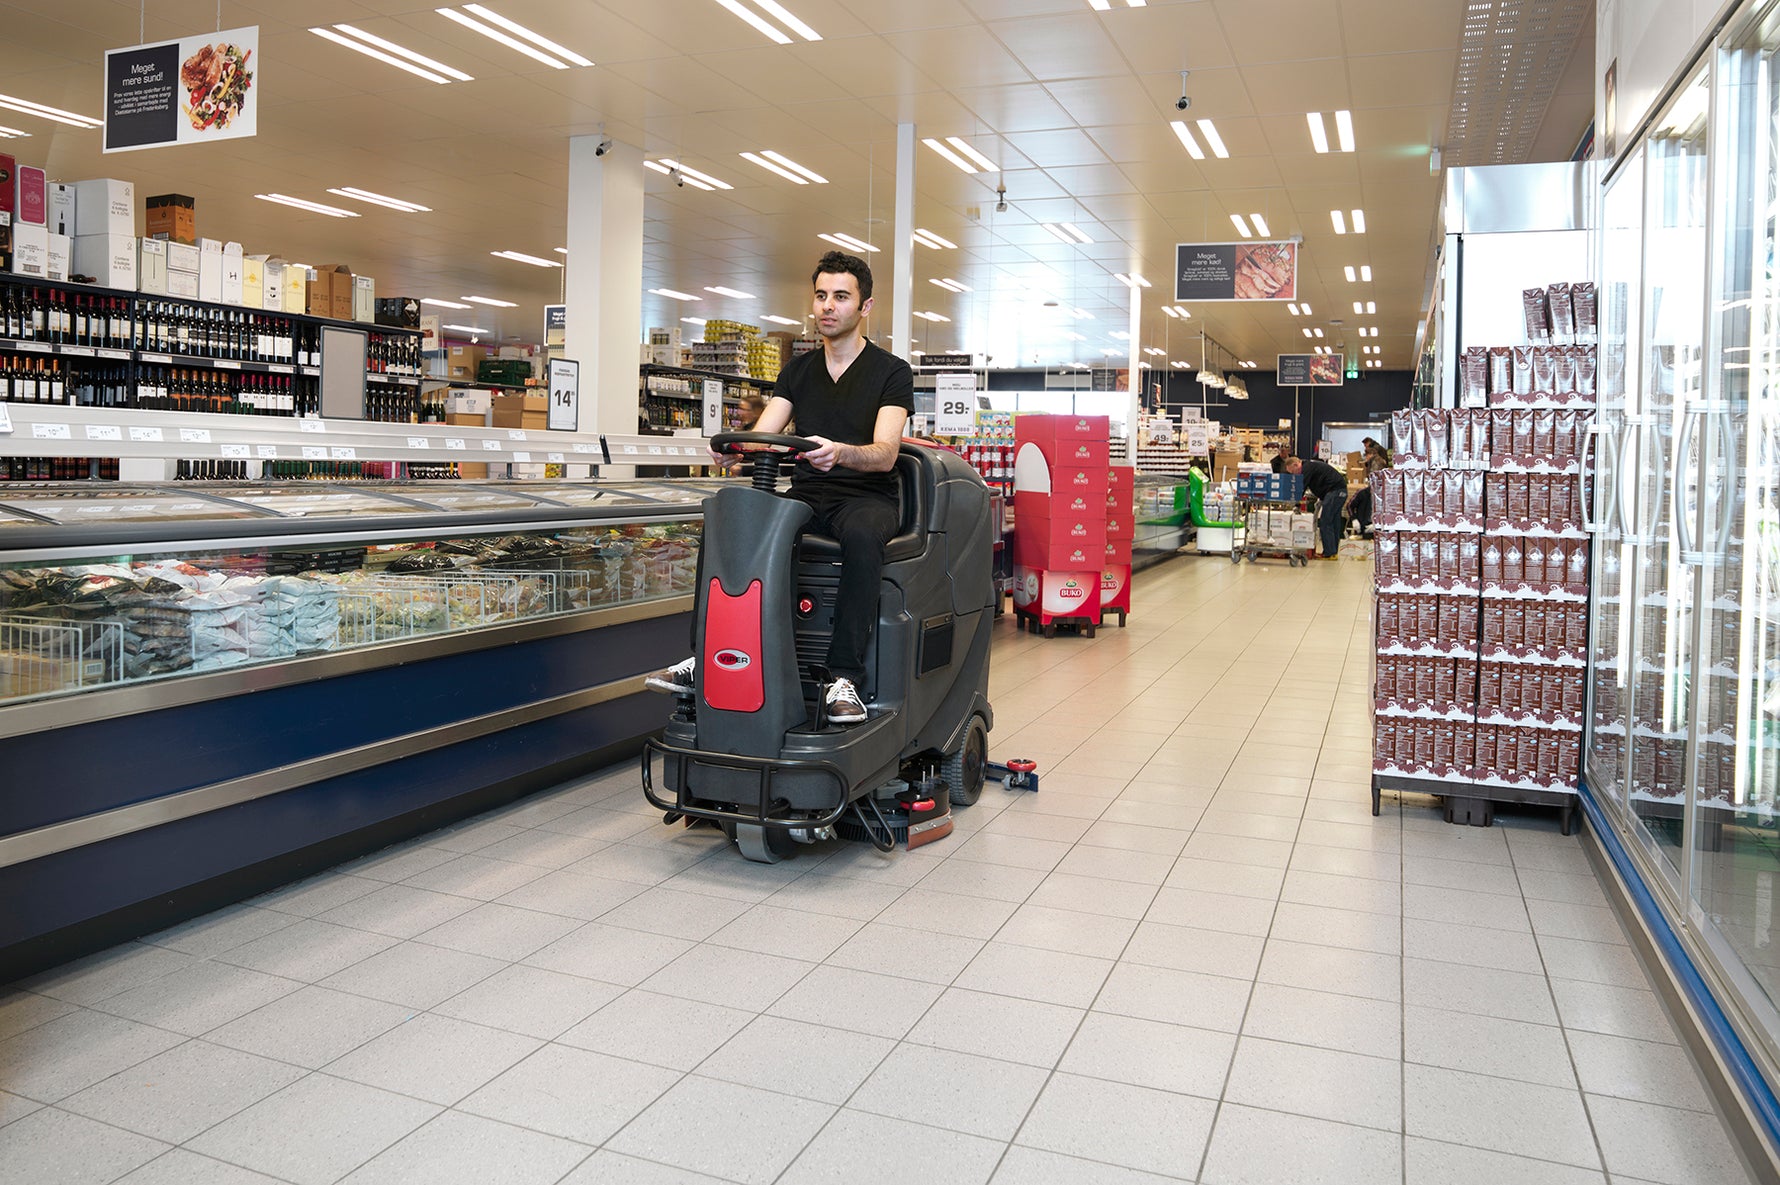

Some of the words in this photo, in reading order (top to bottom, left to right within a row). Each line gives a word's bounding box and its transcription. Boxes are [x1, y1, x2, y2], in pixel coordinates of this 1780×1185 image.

[131, 63, 155, 74] Meget
[122, 77, 142, 86] mere
[143, 71, 164, 83] sund!
[1196, 252, 1217, 261] Meget
[554, 389, 572, 408] 14
[710, 403, 716, 418] 9
[1061, 588, 1082, 597] BUKO
[720, 655, 749, 664] VIPER
